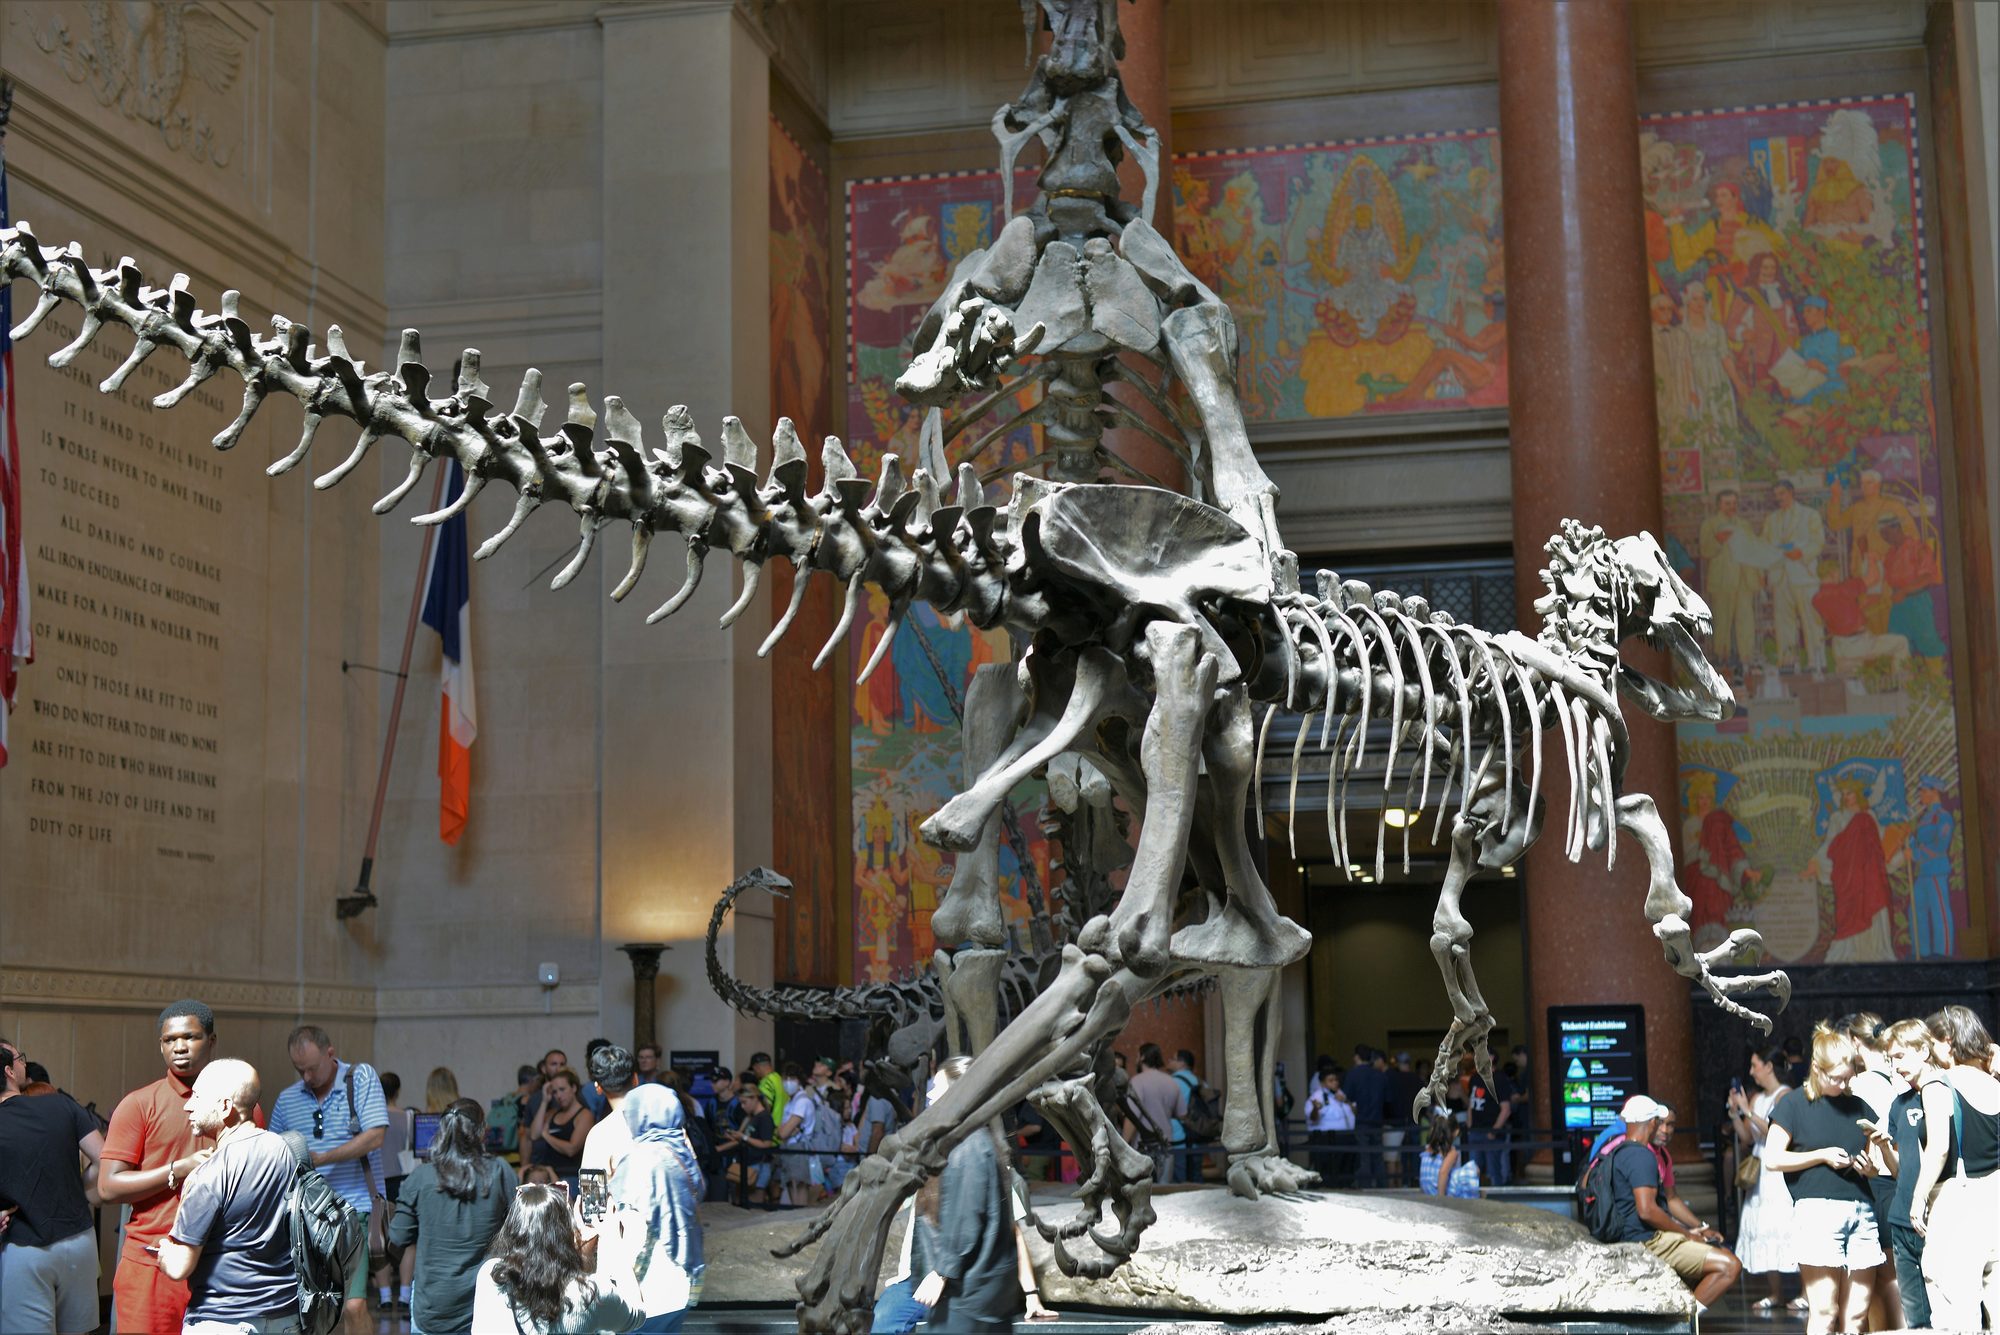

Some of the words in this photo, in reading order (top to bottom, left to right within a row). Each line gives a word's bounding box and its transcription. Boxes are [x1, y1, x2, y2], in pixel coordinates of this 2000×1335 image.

[158, 370, 170, 388] TO
[64, 400, 76, 418] IT
[82, 408, 94, 426] IS
[100, 415, 133, 442] HARD
[139, 431, 154, 450] TO
[158, 440, 182, 463] FAIL
[187, 452, 208, 473] BUT
[212, 463, 223, 480] IT
[40, 467, 57, 487] TO
[63, 476, 120, 510] SUCCEED
[41, 429, 53, 446] IS
[57, 435, 97, 464] WORSE
[102, 454, 138, 481] NEVER
[142, 469, 157, 488] TO
[161, 478, 188, 501] HAVE
[192, 490, 223, 514] TRIED
[60, 514, 82, 534] ALL
[88, 522, 135, 552] DARING
[140, 542, 164, 563] AND
[169, 551, 222, 583] COURAGE
[37, 544, 56, 564] ALL
[58, 550, 85, 572] IRON
[88, 559, 147, 593] ENDURANCE
[149, 581, 162, 597] OF
[165, 586, 221, 617] MISFORTUNE
[35, 621, 51, 639] OF
[57, 627, 119, 657] MANHOOD
[37, 582, 67, 606] MAKE
[73, 593, 97, 615] FOR
[101, 602, 108, 617] A
[112, 605, 146, 629] FINER
[150, 617, 193, 643] NOBLER
[196, 631, 220, 652] TYPE
[56, 665, 88, 687] ONLY
[92, 674, 130, 698] THOSE
[133, 685, 154, 704] ARE
[158, 691, 175, 709] FIT
[179, 696, 193, 713] TO
[196, 700, 218, 719] LIVE
[32, 698, 59, 719] WHO
[62, 705, 79, 722] DO
[82, 710, 104, 729] NOT
[107, 715, 131, 737] FEAR
[132, 721, 147, 738] TO
[149, 725, 166, 743] DIE
[168, 730, 189, 748] AND
[191, 735, 218, 754] NONE
[32, 737, 53, 757] ARE
[57, 743, 75, 761] FIT
[79, 747, 94, 764] TO
[98, 752, 117, 769] DIE
[119, 755, 145, 774] WHO
[148, 761, 174, 782] HAVE
[176, 767, 217, 789] SHRUNK
[31, 777, 65, 798] FROM
[70, 784, 93, 803] THE
[97, 789, 120, 807] JOY
[123, 794, 139, 810] OF
[143, 797, 166, 816] LIFE
[169, 801, 192, 820] AND
[195, 807, 217, 825] THE
[29, 816, 64, 836] DUTY
[68, 823, 83, 840] OF
[88, 826, 113, 843] LIFE
